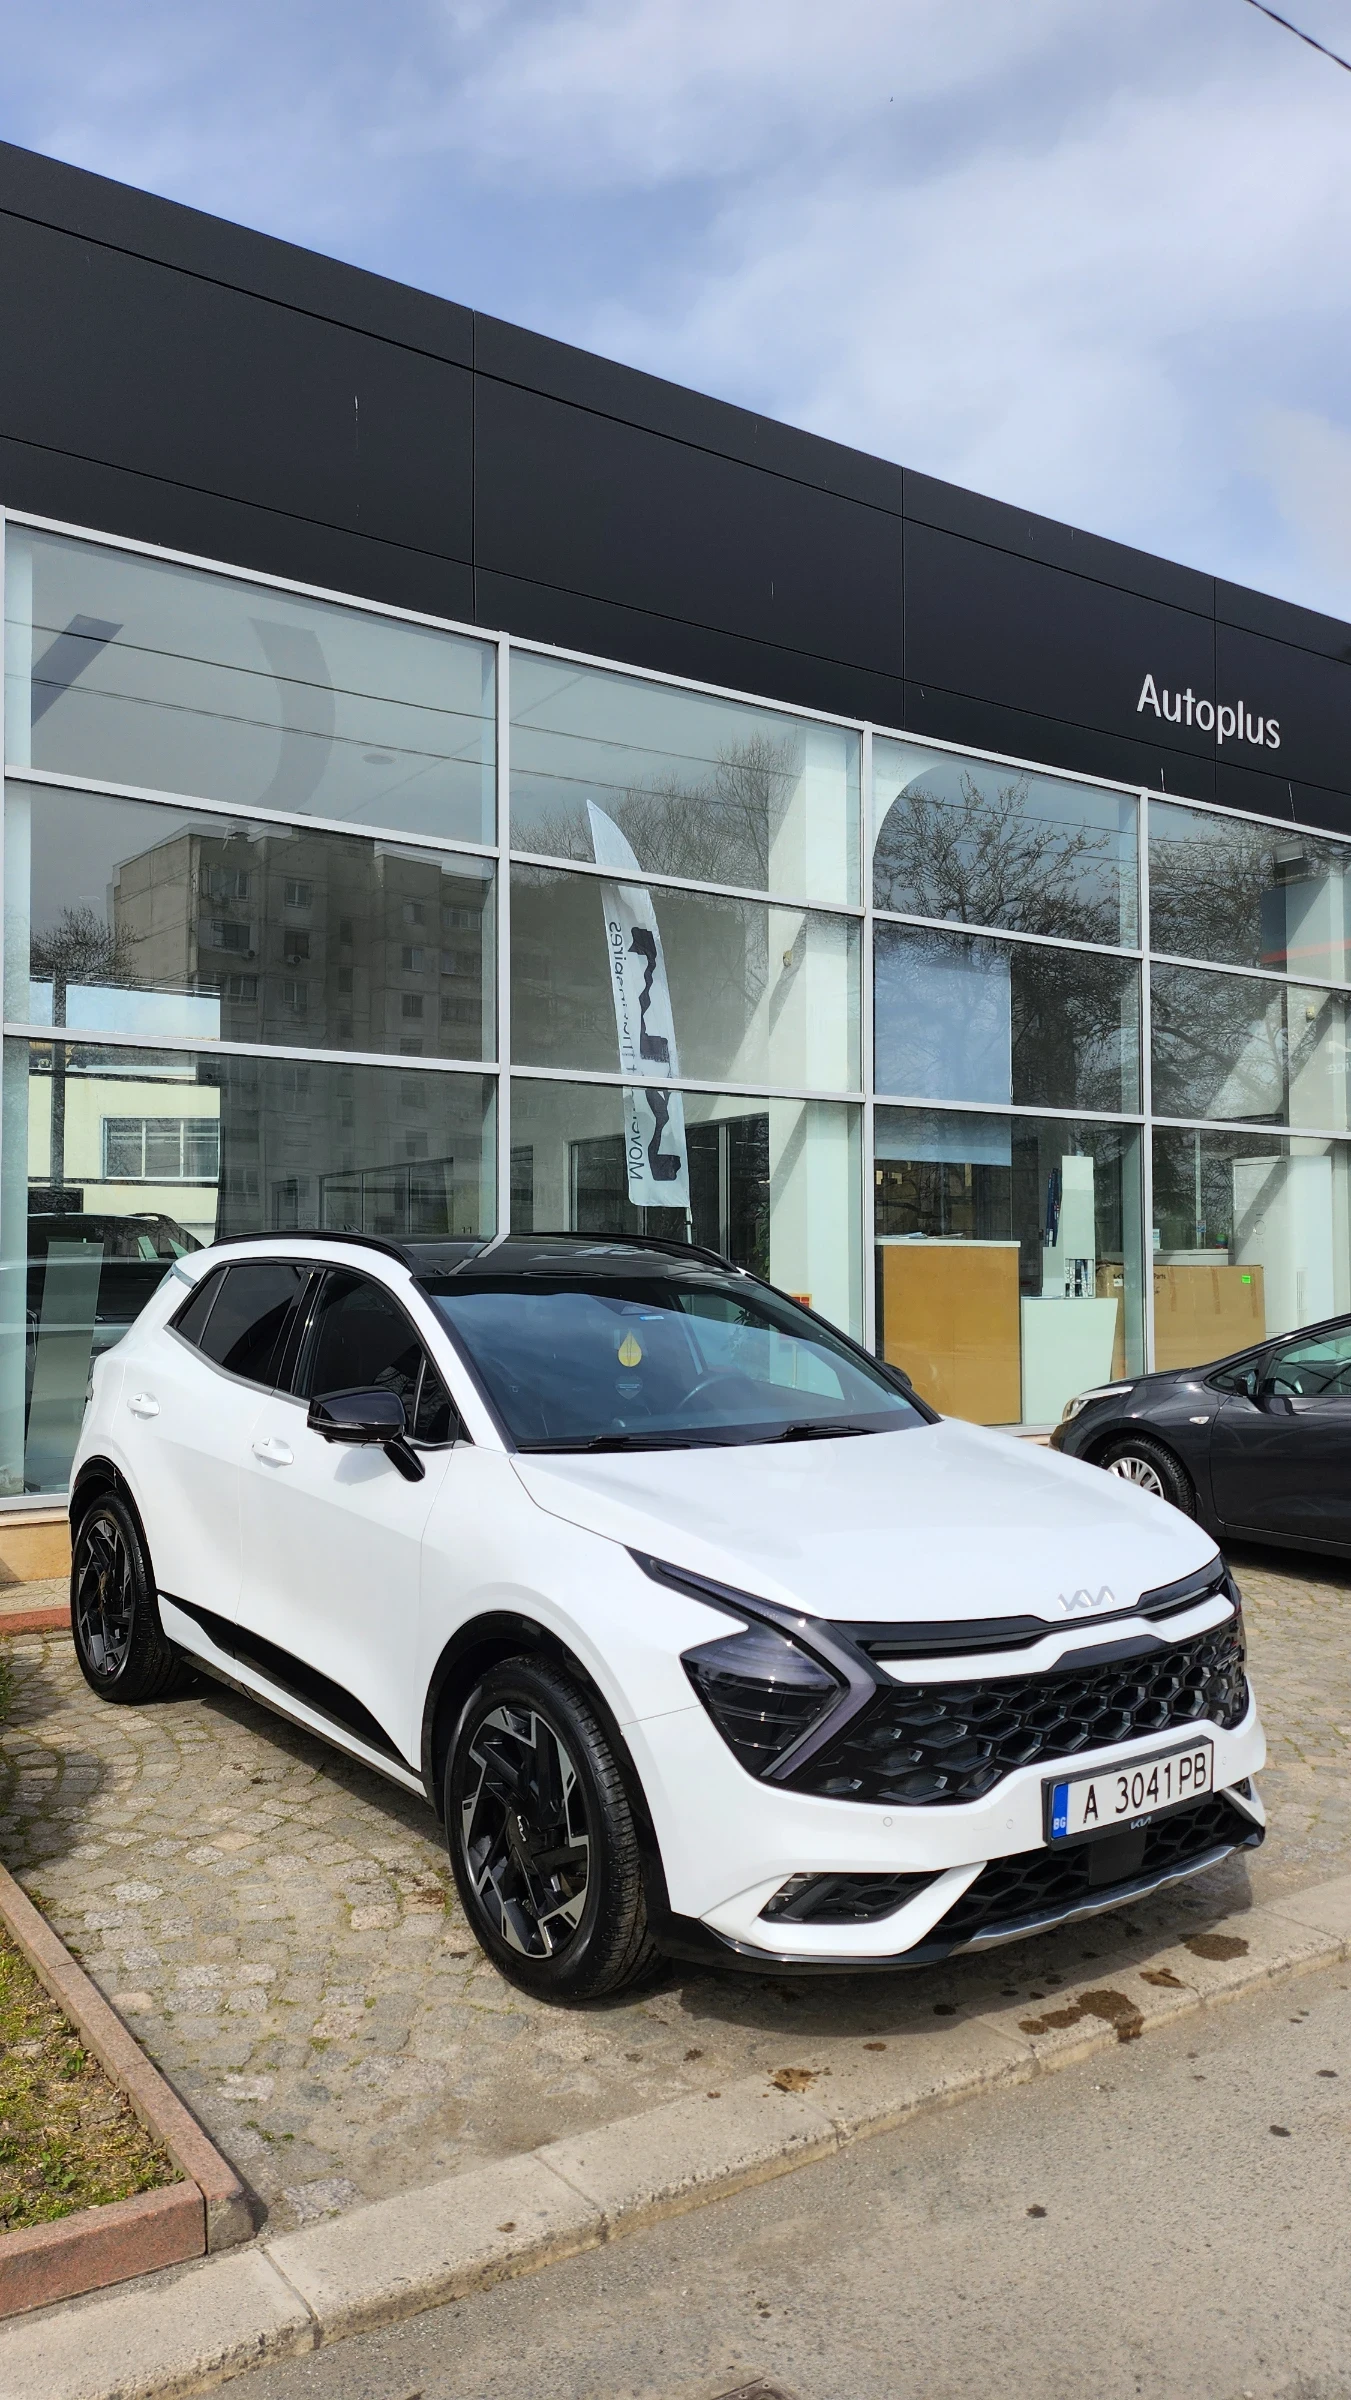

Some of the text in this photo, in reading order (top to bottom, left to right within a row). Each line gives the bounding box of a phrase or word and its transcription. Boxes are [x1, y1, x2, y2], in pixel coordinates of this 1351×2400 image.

[1136, 673, 1281, 749] Autoplus
[1053, 1816, 1067, 1831] BG
[1083, 1784, 1099, 1824] A
